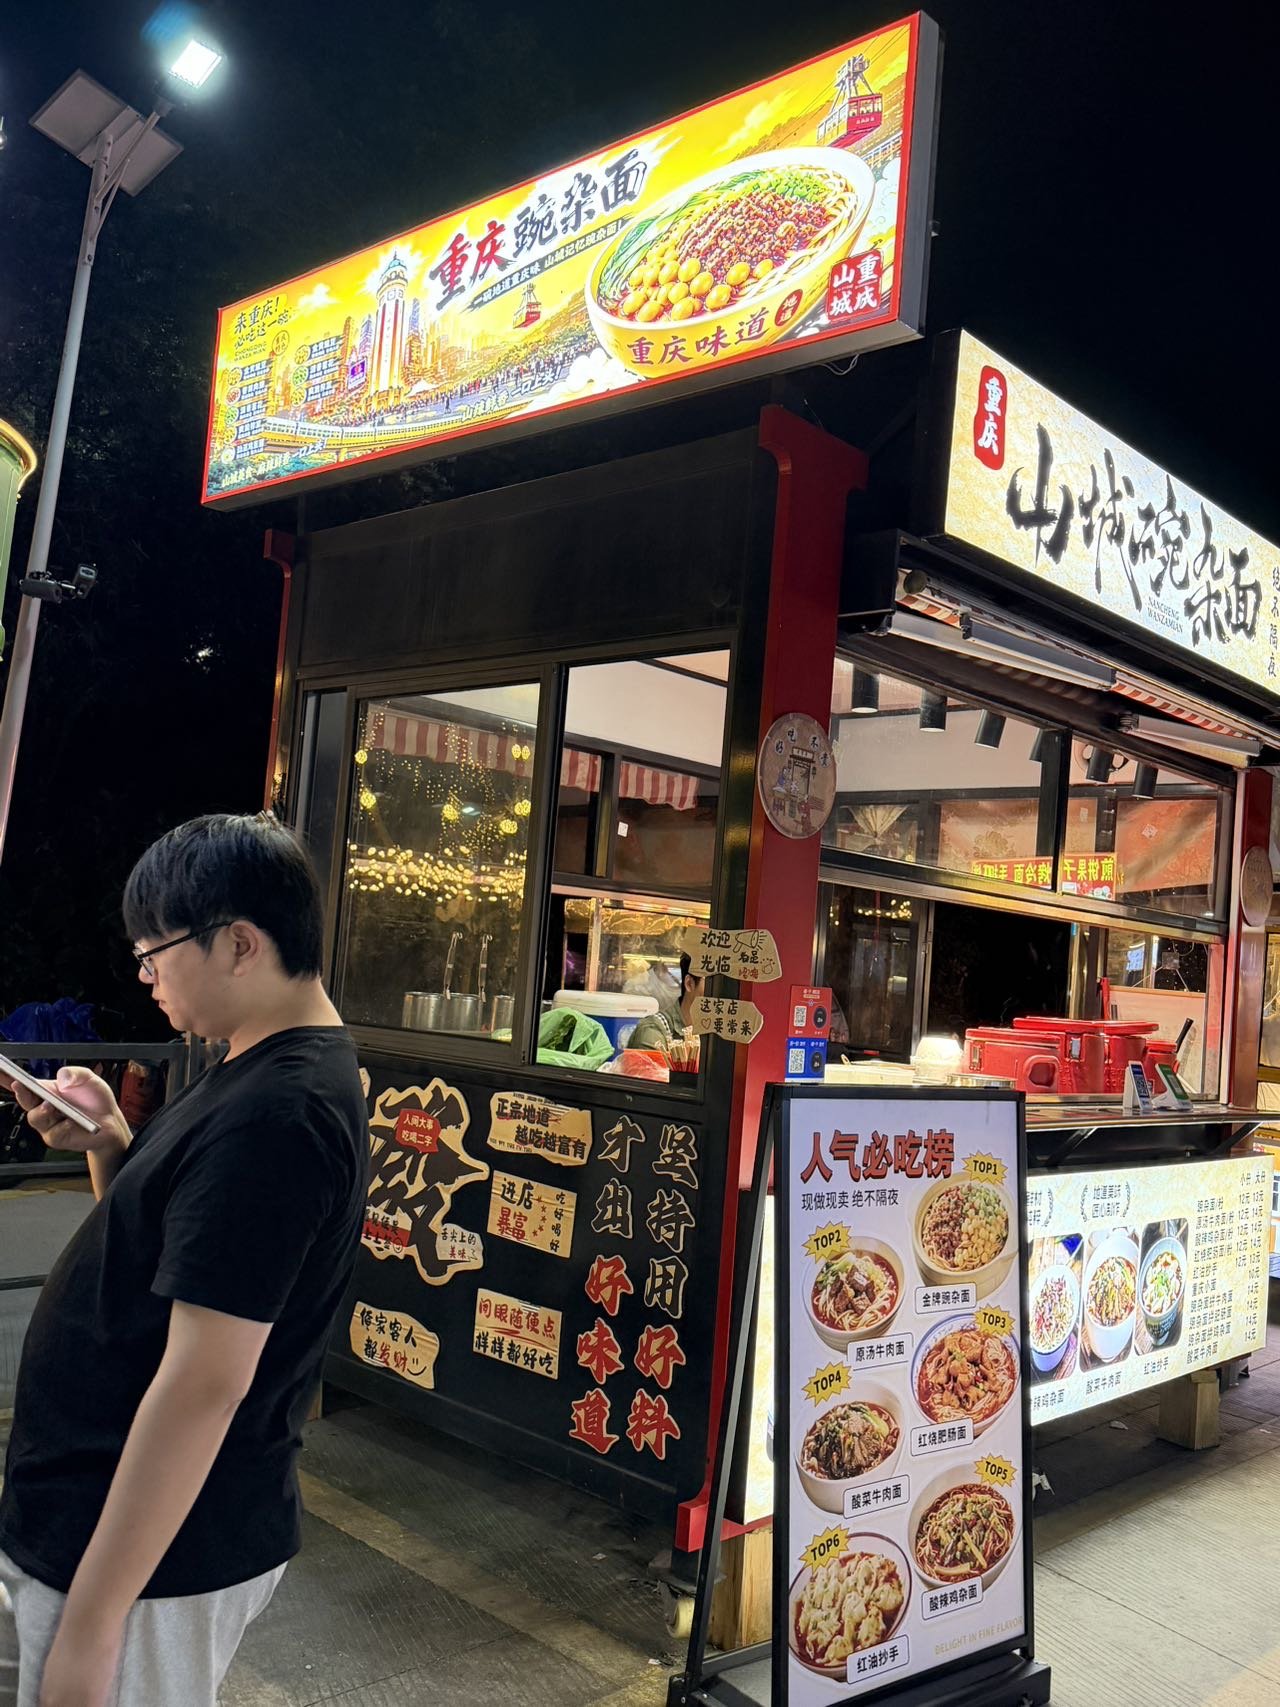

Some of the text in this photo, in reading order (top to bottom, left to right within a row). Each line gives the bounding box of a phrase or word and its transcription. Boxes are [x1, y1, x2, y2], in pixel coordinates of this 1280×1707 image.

[429, 149, 648, 311] 重庆豌杂面
[626, 306, 769, 367] 重庆味道
[977, 376, 1003, 456] 重庆
[1006, 421, 1262, 649] 山城碗杂面
[775, 726, 830, 767] 好吃不贵
[700, 930, 732, 949] 欢迎
[700, 954, 732, 974] 光临
[700, 999, 739, 1016] 这家店
[713, 1017, 753, 1037] 要常来
[403, 1113, 434, 1131] 人间大事
[496, 1098, 550, 1128] 正宗地道
[401, 1129, 433, 1147] 吃喝二字
[514, 1123, 587, 1160] 越吃越富有
[800, 1128, 955, 1184] 人气必吃榜
[972, 1159, 999, 1176] TOP1
[500, 1177, 535, 1210] 进店
[801, 1189, 900, 1211] 现做现卖 绝不隔夜
[496, 1206, 529, 1241] 暴富
[549, 1191, 567, 1253] 吃好喝好
[440, 1227, 477, 1246] 舌尖上的
[813, 1229, 842, 1251] TOP2
[448, 1245, 466, 1260] 美味
[569, 1114, 646, 1454] 才出好味道
[626, 1124, 698, 1461] 坚持用好料
[981, 1311, 1007, 1329] TOP3
[363, 1335, 408, 1373] 都发财
[474, 1330, 554, 1375] 样样都好吃
[855, 1343, 905, 1363] 原汤牛肉面
[812, 1372, 842, 1395] TOP4
[917, 1425, 967, 1449] 红烧肥肠面
[984, 1460, 1009, 1481] TOP5
[851, 1483, 902, 1511] 酸菜牛肉面
[810, 1533, 841, 1555] TOP6
[929, 1583, 978, 1613] 酸辣鸡杂面
[978, 1624, 995, 1641] FINE
[856, 1644, 900, 1674] 红油抄手
